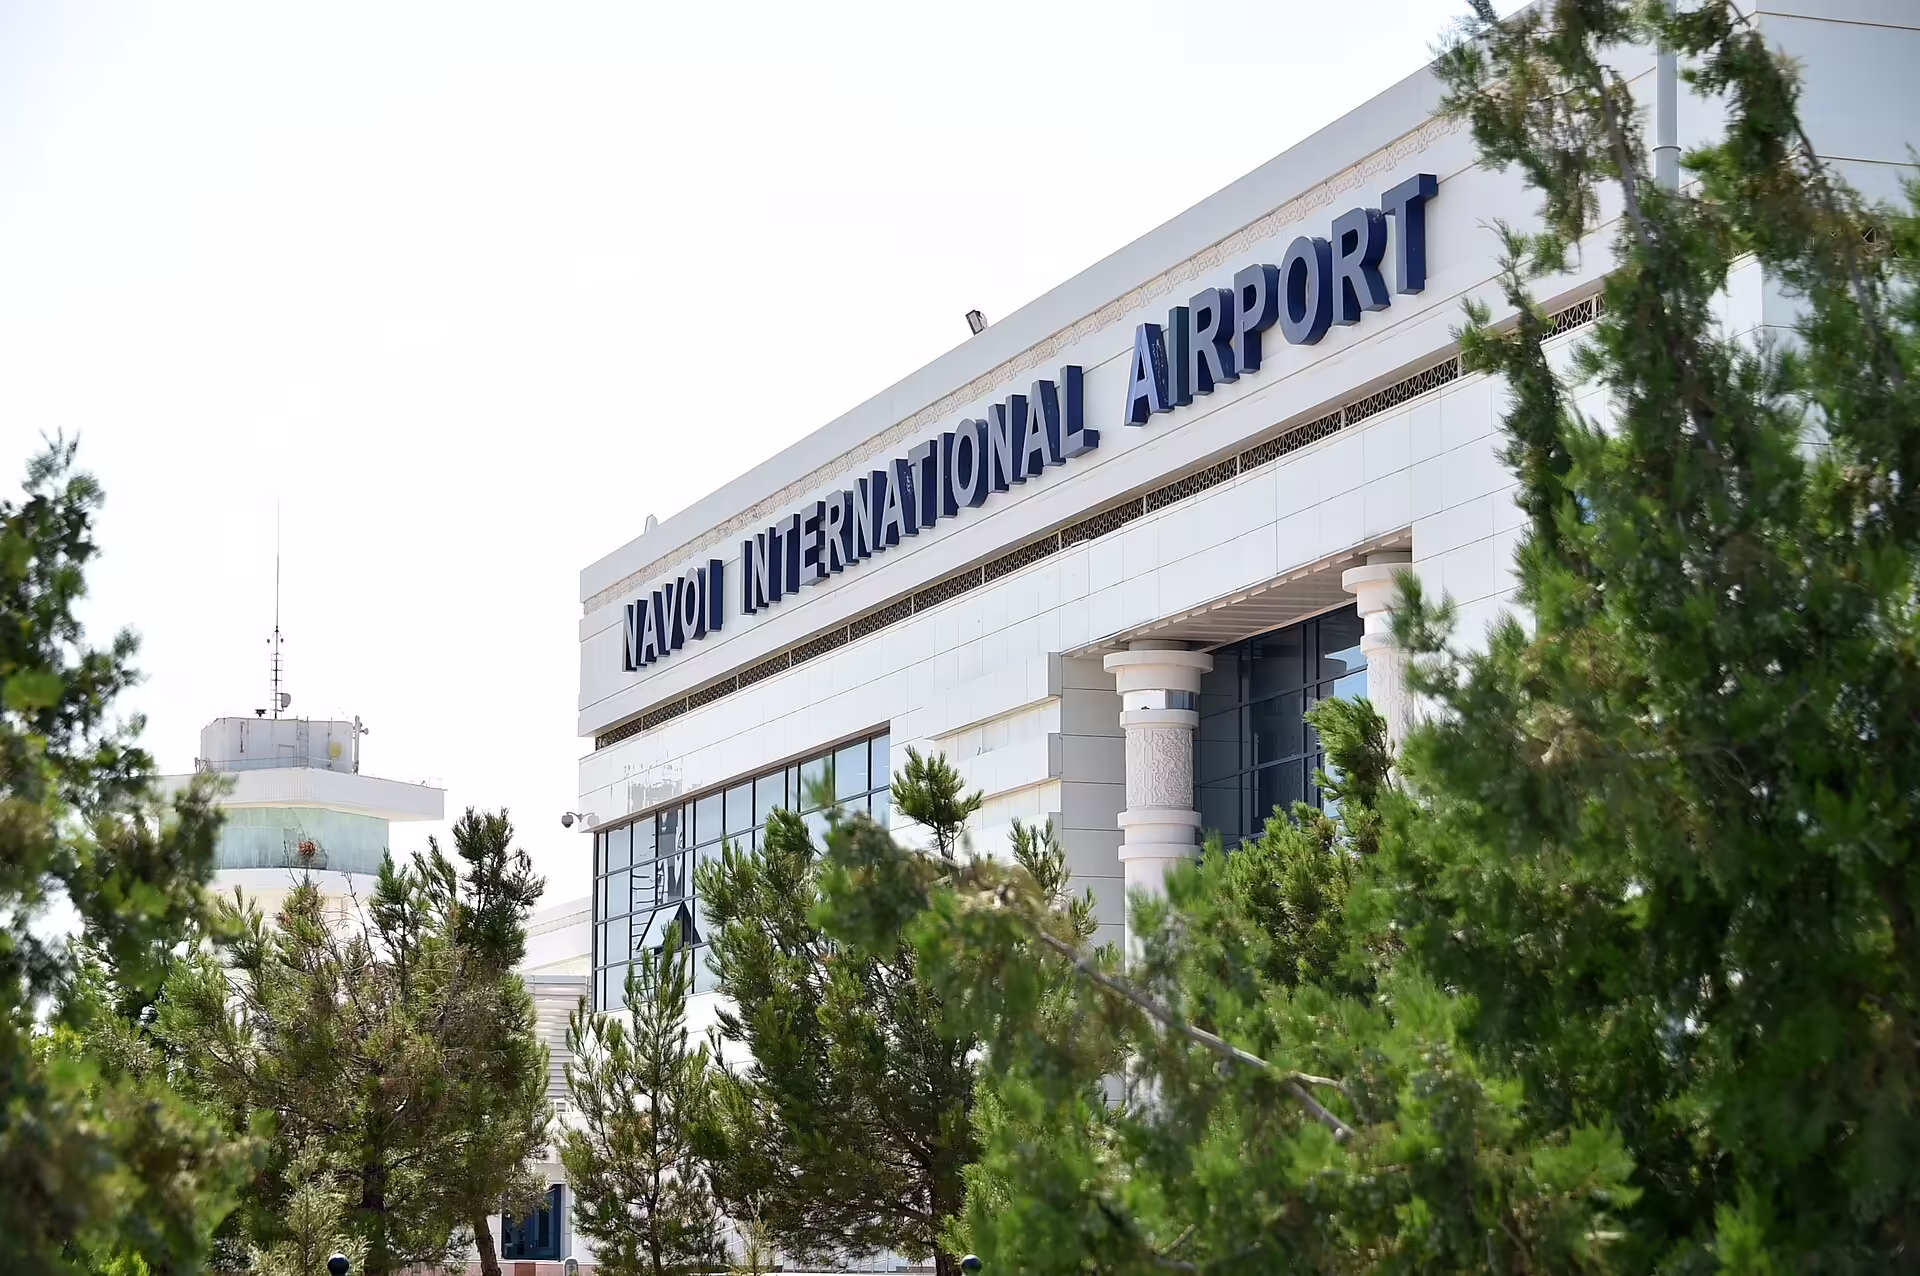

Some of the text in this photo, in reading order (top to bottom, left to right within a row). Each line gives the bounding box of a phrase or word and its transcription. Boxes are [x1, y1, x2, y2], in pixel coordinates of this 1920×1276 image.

[622, 173, 1437, 672] NAVOI INTERNATIONAL AIRPORT
